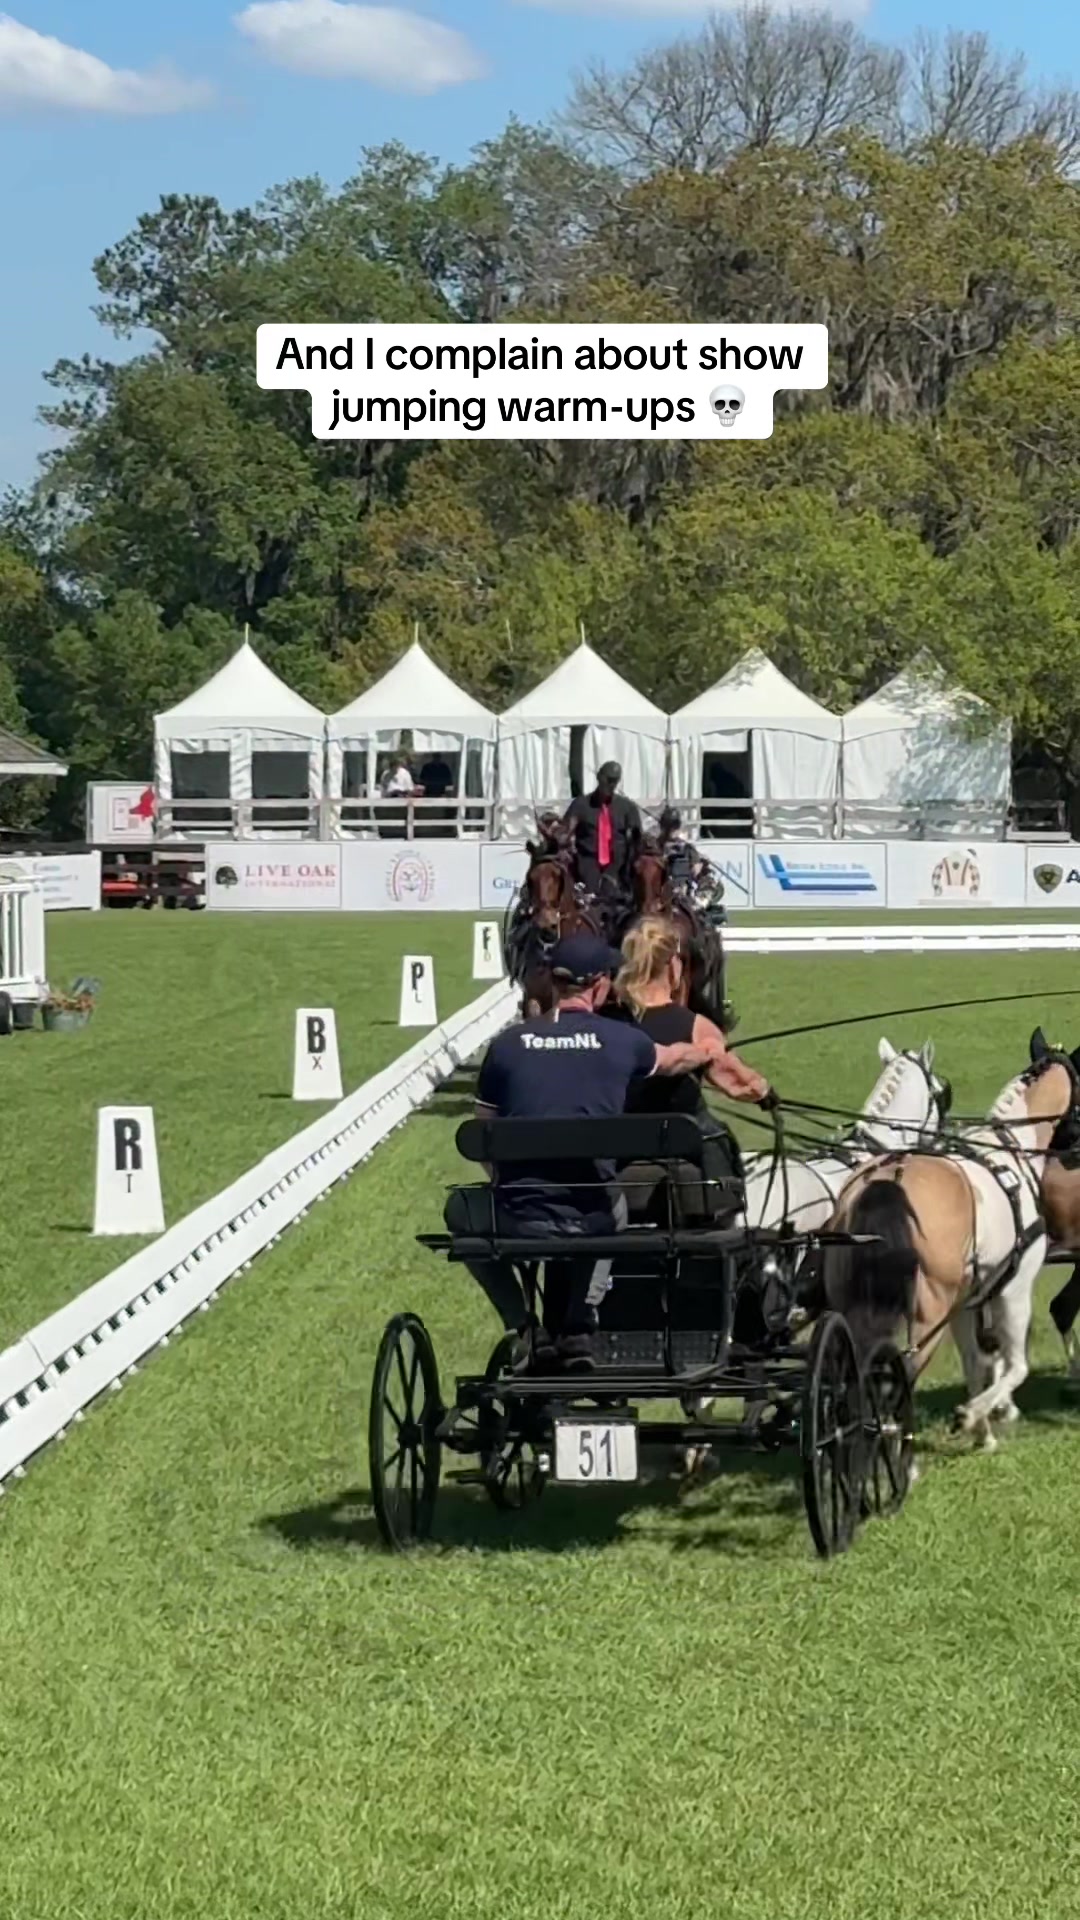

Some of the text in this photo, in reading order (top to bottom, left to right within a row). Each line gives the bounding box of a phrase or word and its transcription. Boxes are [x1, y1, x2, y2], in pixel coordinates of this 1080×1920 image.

[245, 864, 336, 877] LIVE OAK
[482, 926, 491, 950] F
[412, 962, 424, 990] P
[415, 991, 422, 1003] L
[307, 1016, 325, 1054] B
[520, 1033, 602, 1049] TeamNL
[312, 1056, 323, 1071] X
[113, 1117, 142, 1171] R
[579, 1429, 612, 1477] 51
